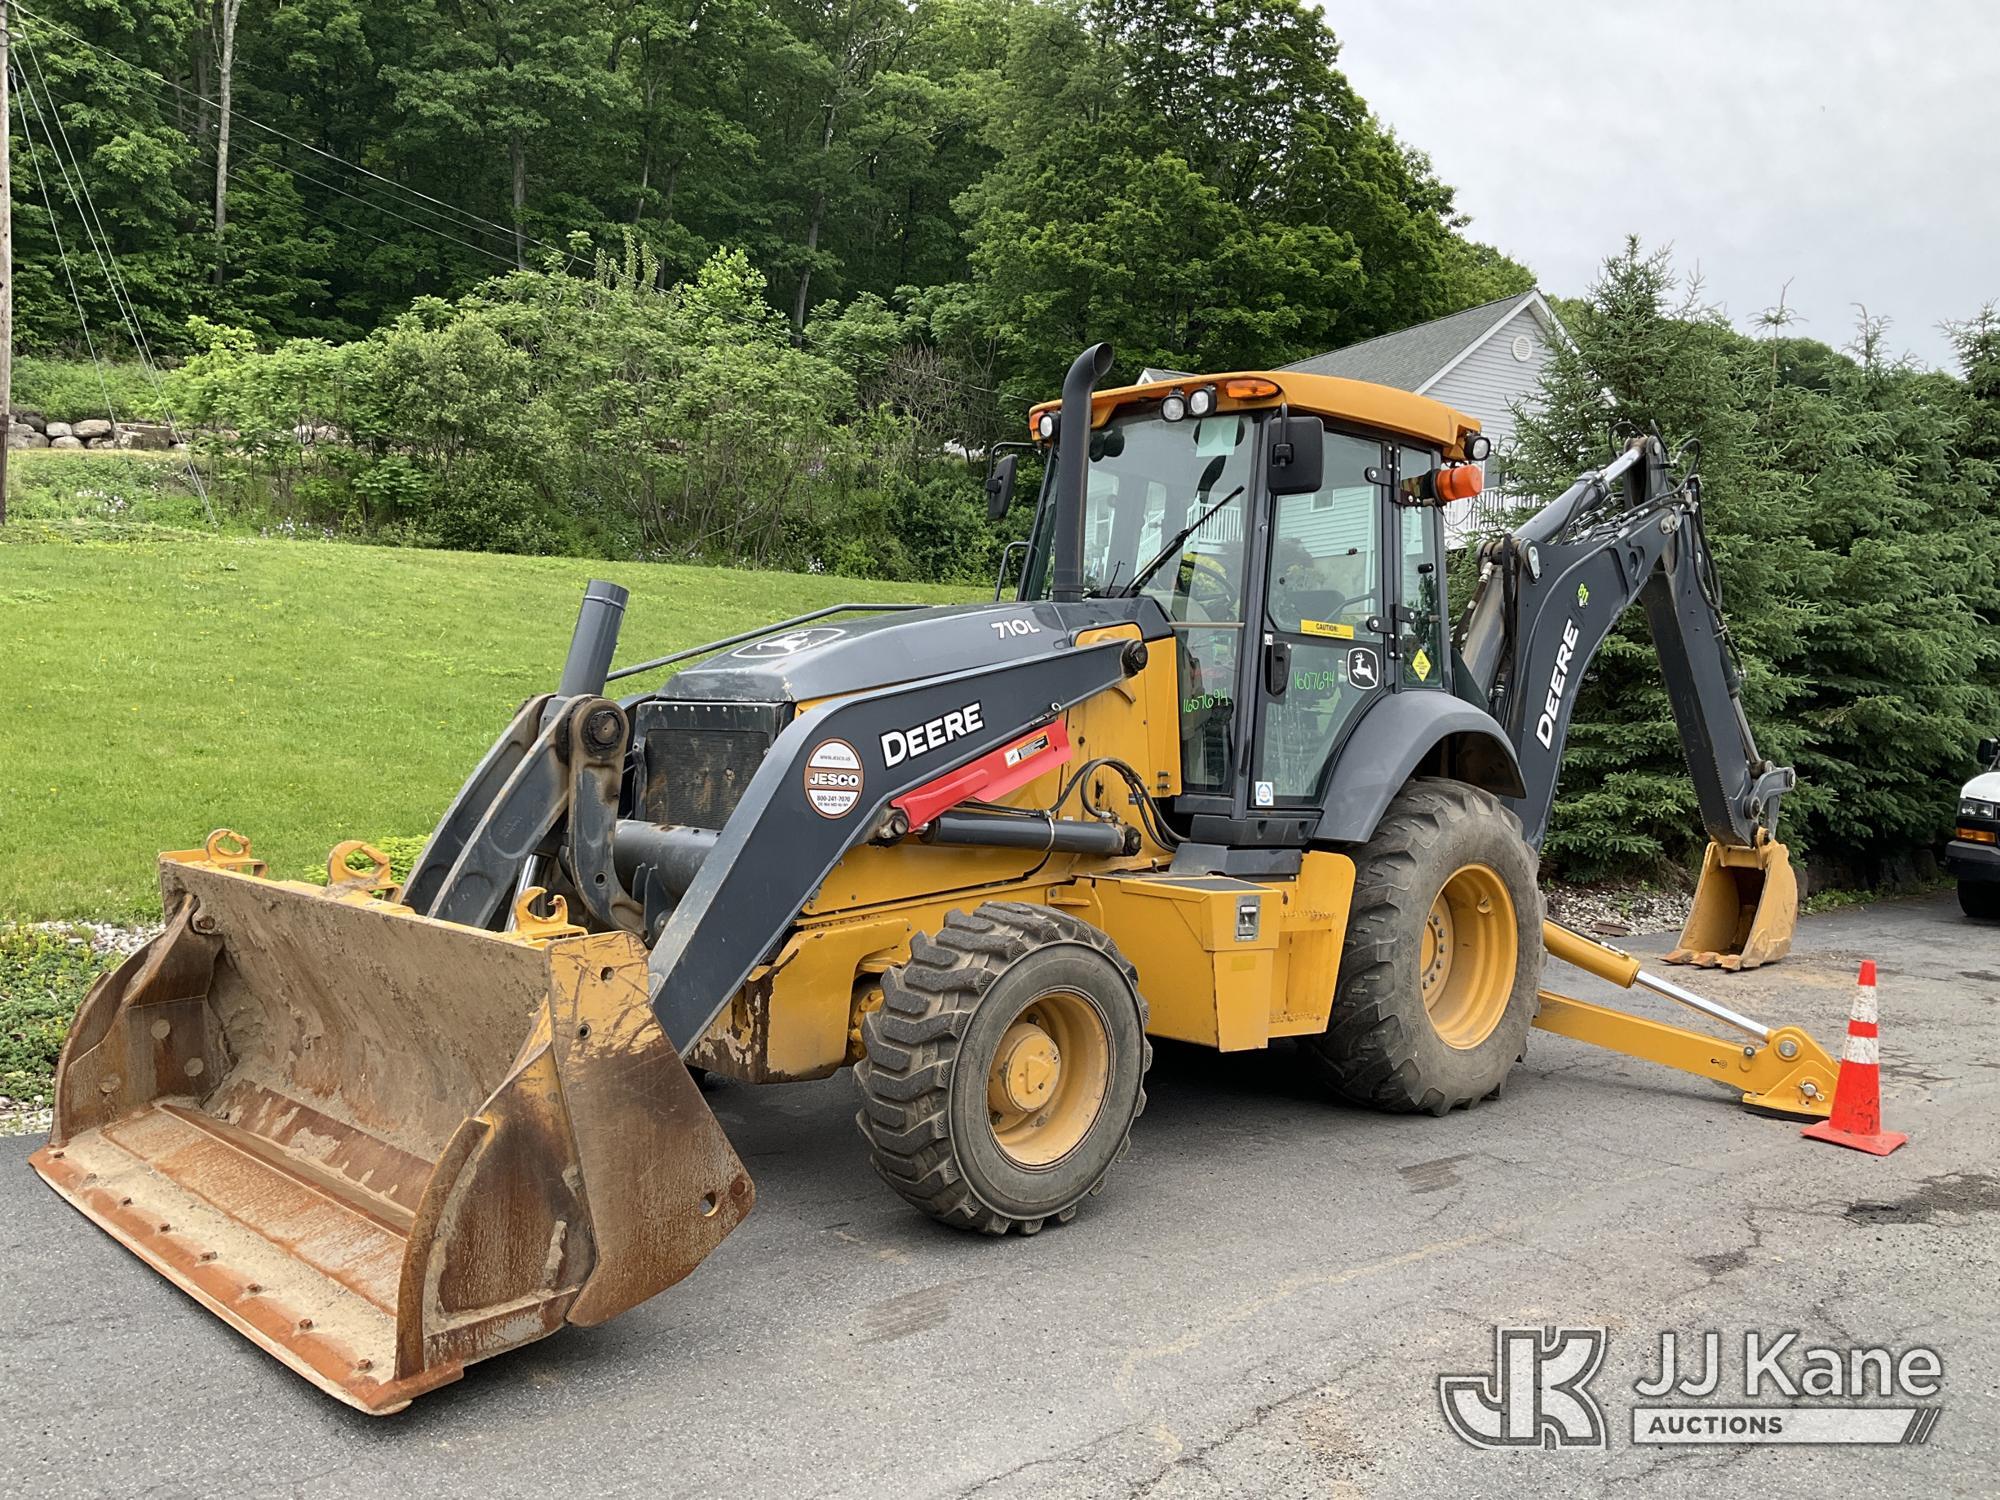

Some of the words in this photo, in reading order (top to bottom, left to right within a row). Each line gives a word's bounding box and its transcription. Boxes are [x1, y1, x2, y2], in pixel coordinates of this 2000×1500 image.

[990, 619, 1041, 639] 710L
[1293, 670, 1335, 690] 1607694
[1536, 618, 1580, 750] DEERE
[1183, 688, 1228, 713] 1607694
[880, 701, 984, 768] DEERE
[809, 773, 859, 787] JESCO
